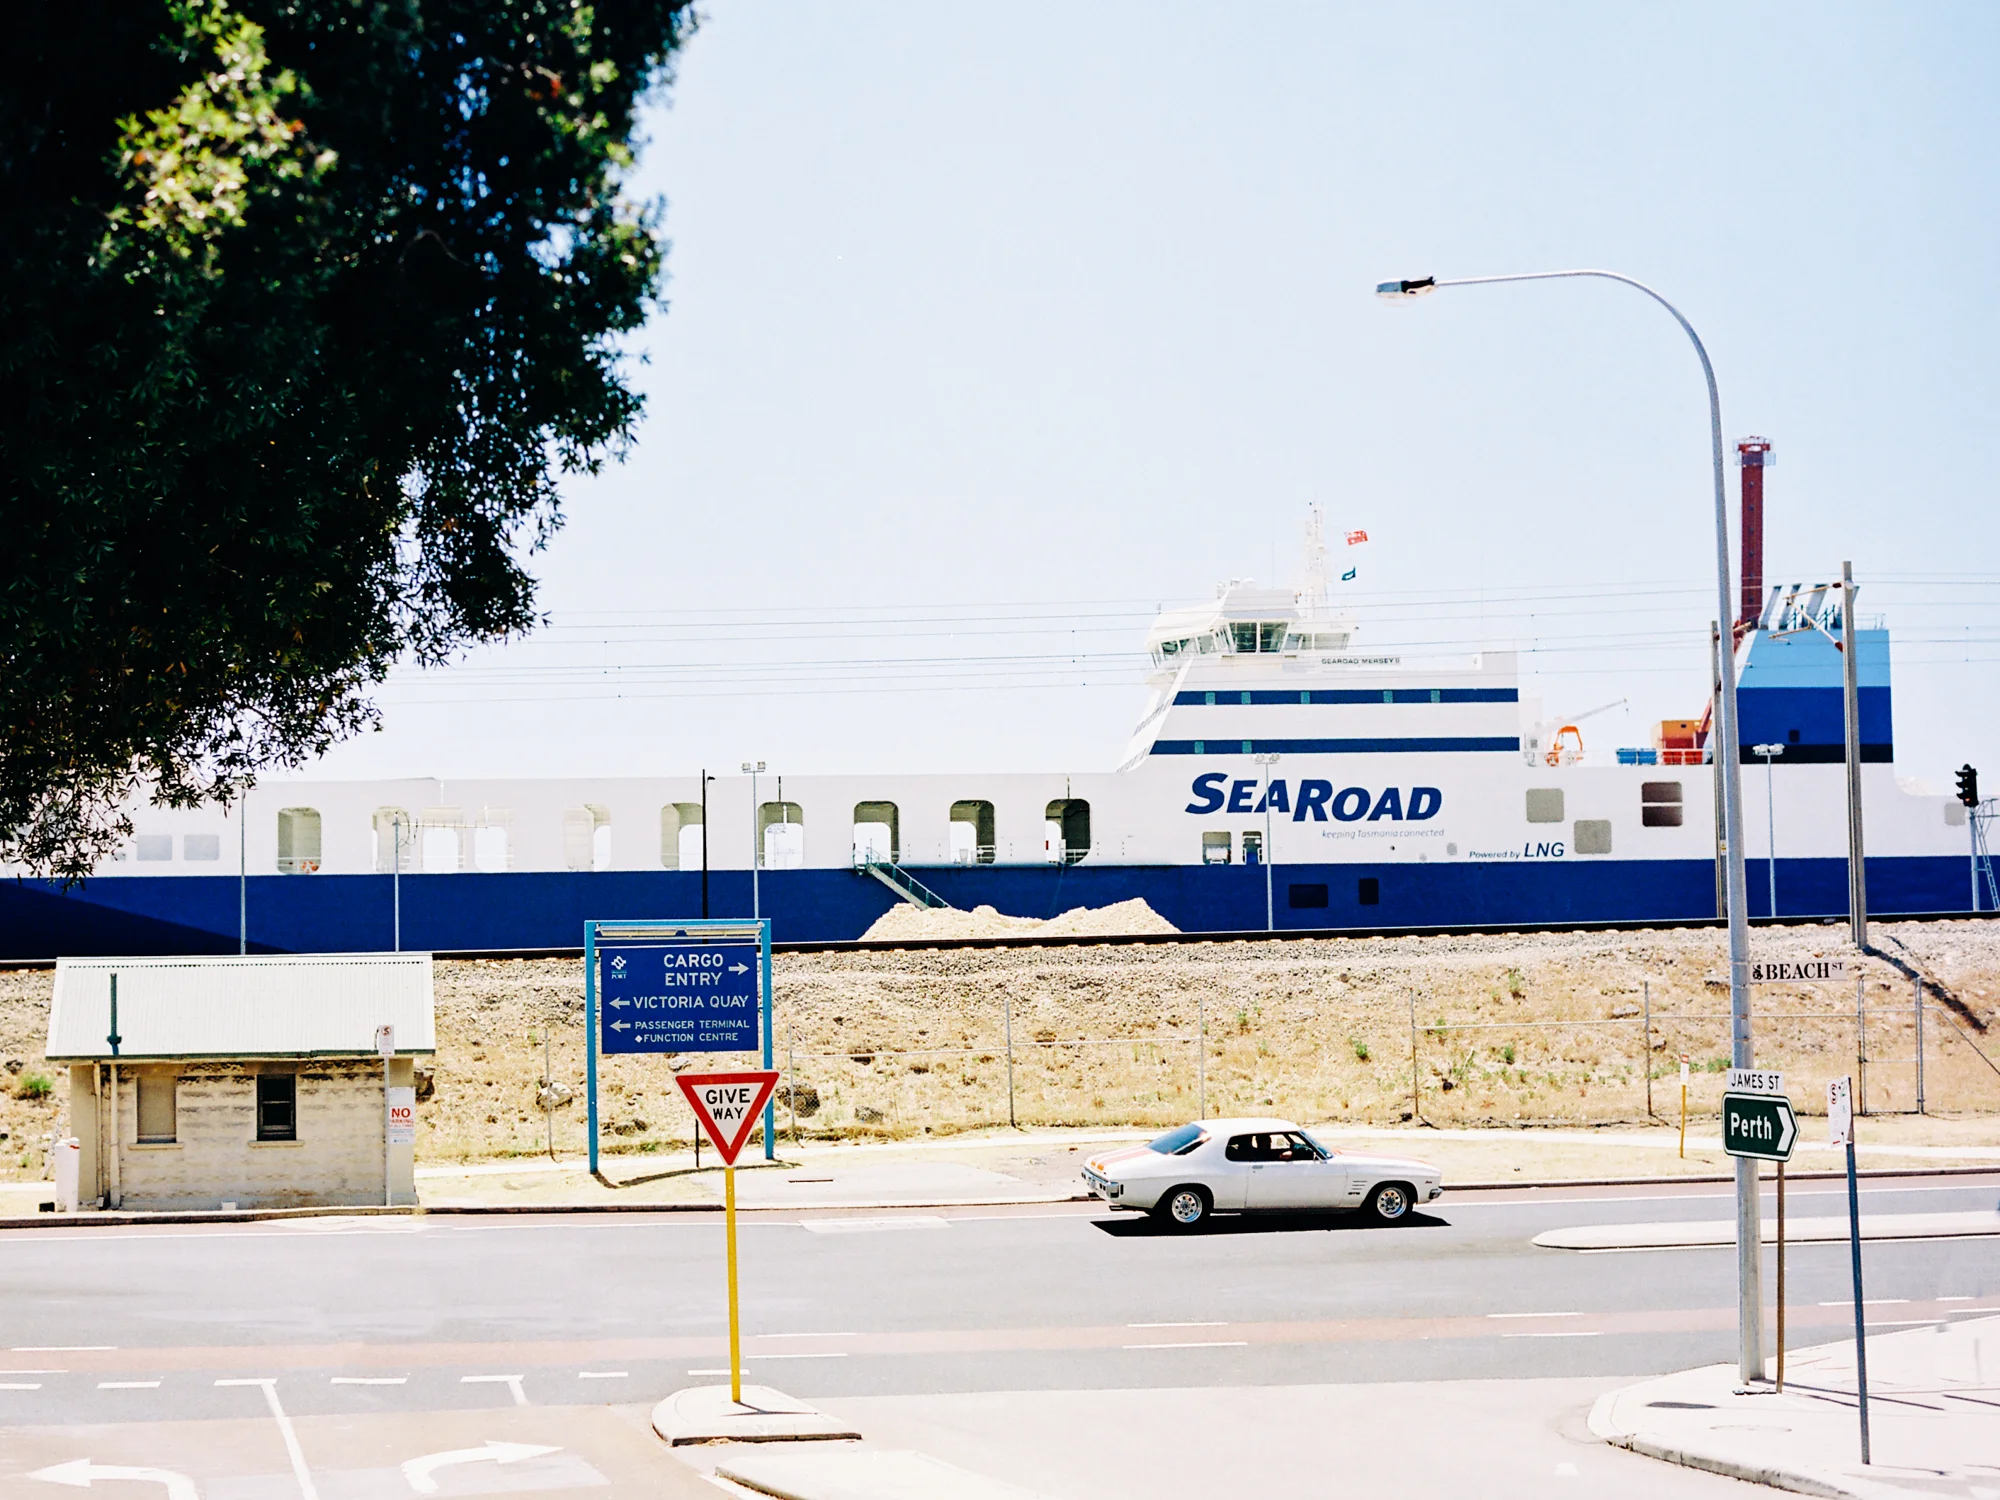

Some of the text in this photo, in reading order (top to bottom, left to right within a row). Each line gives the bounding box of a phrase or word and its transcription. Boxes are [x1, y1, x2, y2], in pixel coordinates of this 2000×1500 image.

[1322, 828, 1444, 839] keeping Tasmania connected
[1469, 842, 1565, 859] Powered by LNG
[663, 953, 723, 968] CARGO
[1766, 962, 1843, 980] BEACH ST
[665, 972, 722, 986] ENTRY
[633, 995, 749, 1009] VICTORIA QUAY
[635, 1020, 750, 1029] PASSENGER TERMINAL
[644, 1033, 738, 1043] FUNCTION CENTRE
[1731, 1073, 1780, 1090] JAMES ST
[706, 1089, 750, 1105] GIVE
[391, 1107, 411, 1118] NO
[713, 1108, 744, 1120] WAY
[1731, 1112, 1772, 1140] Perth
